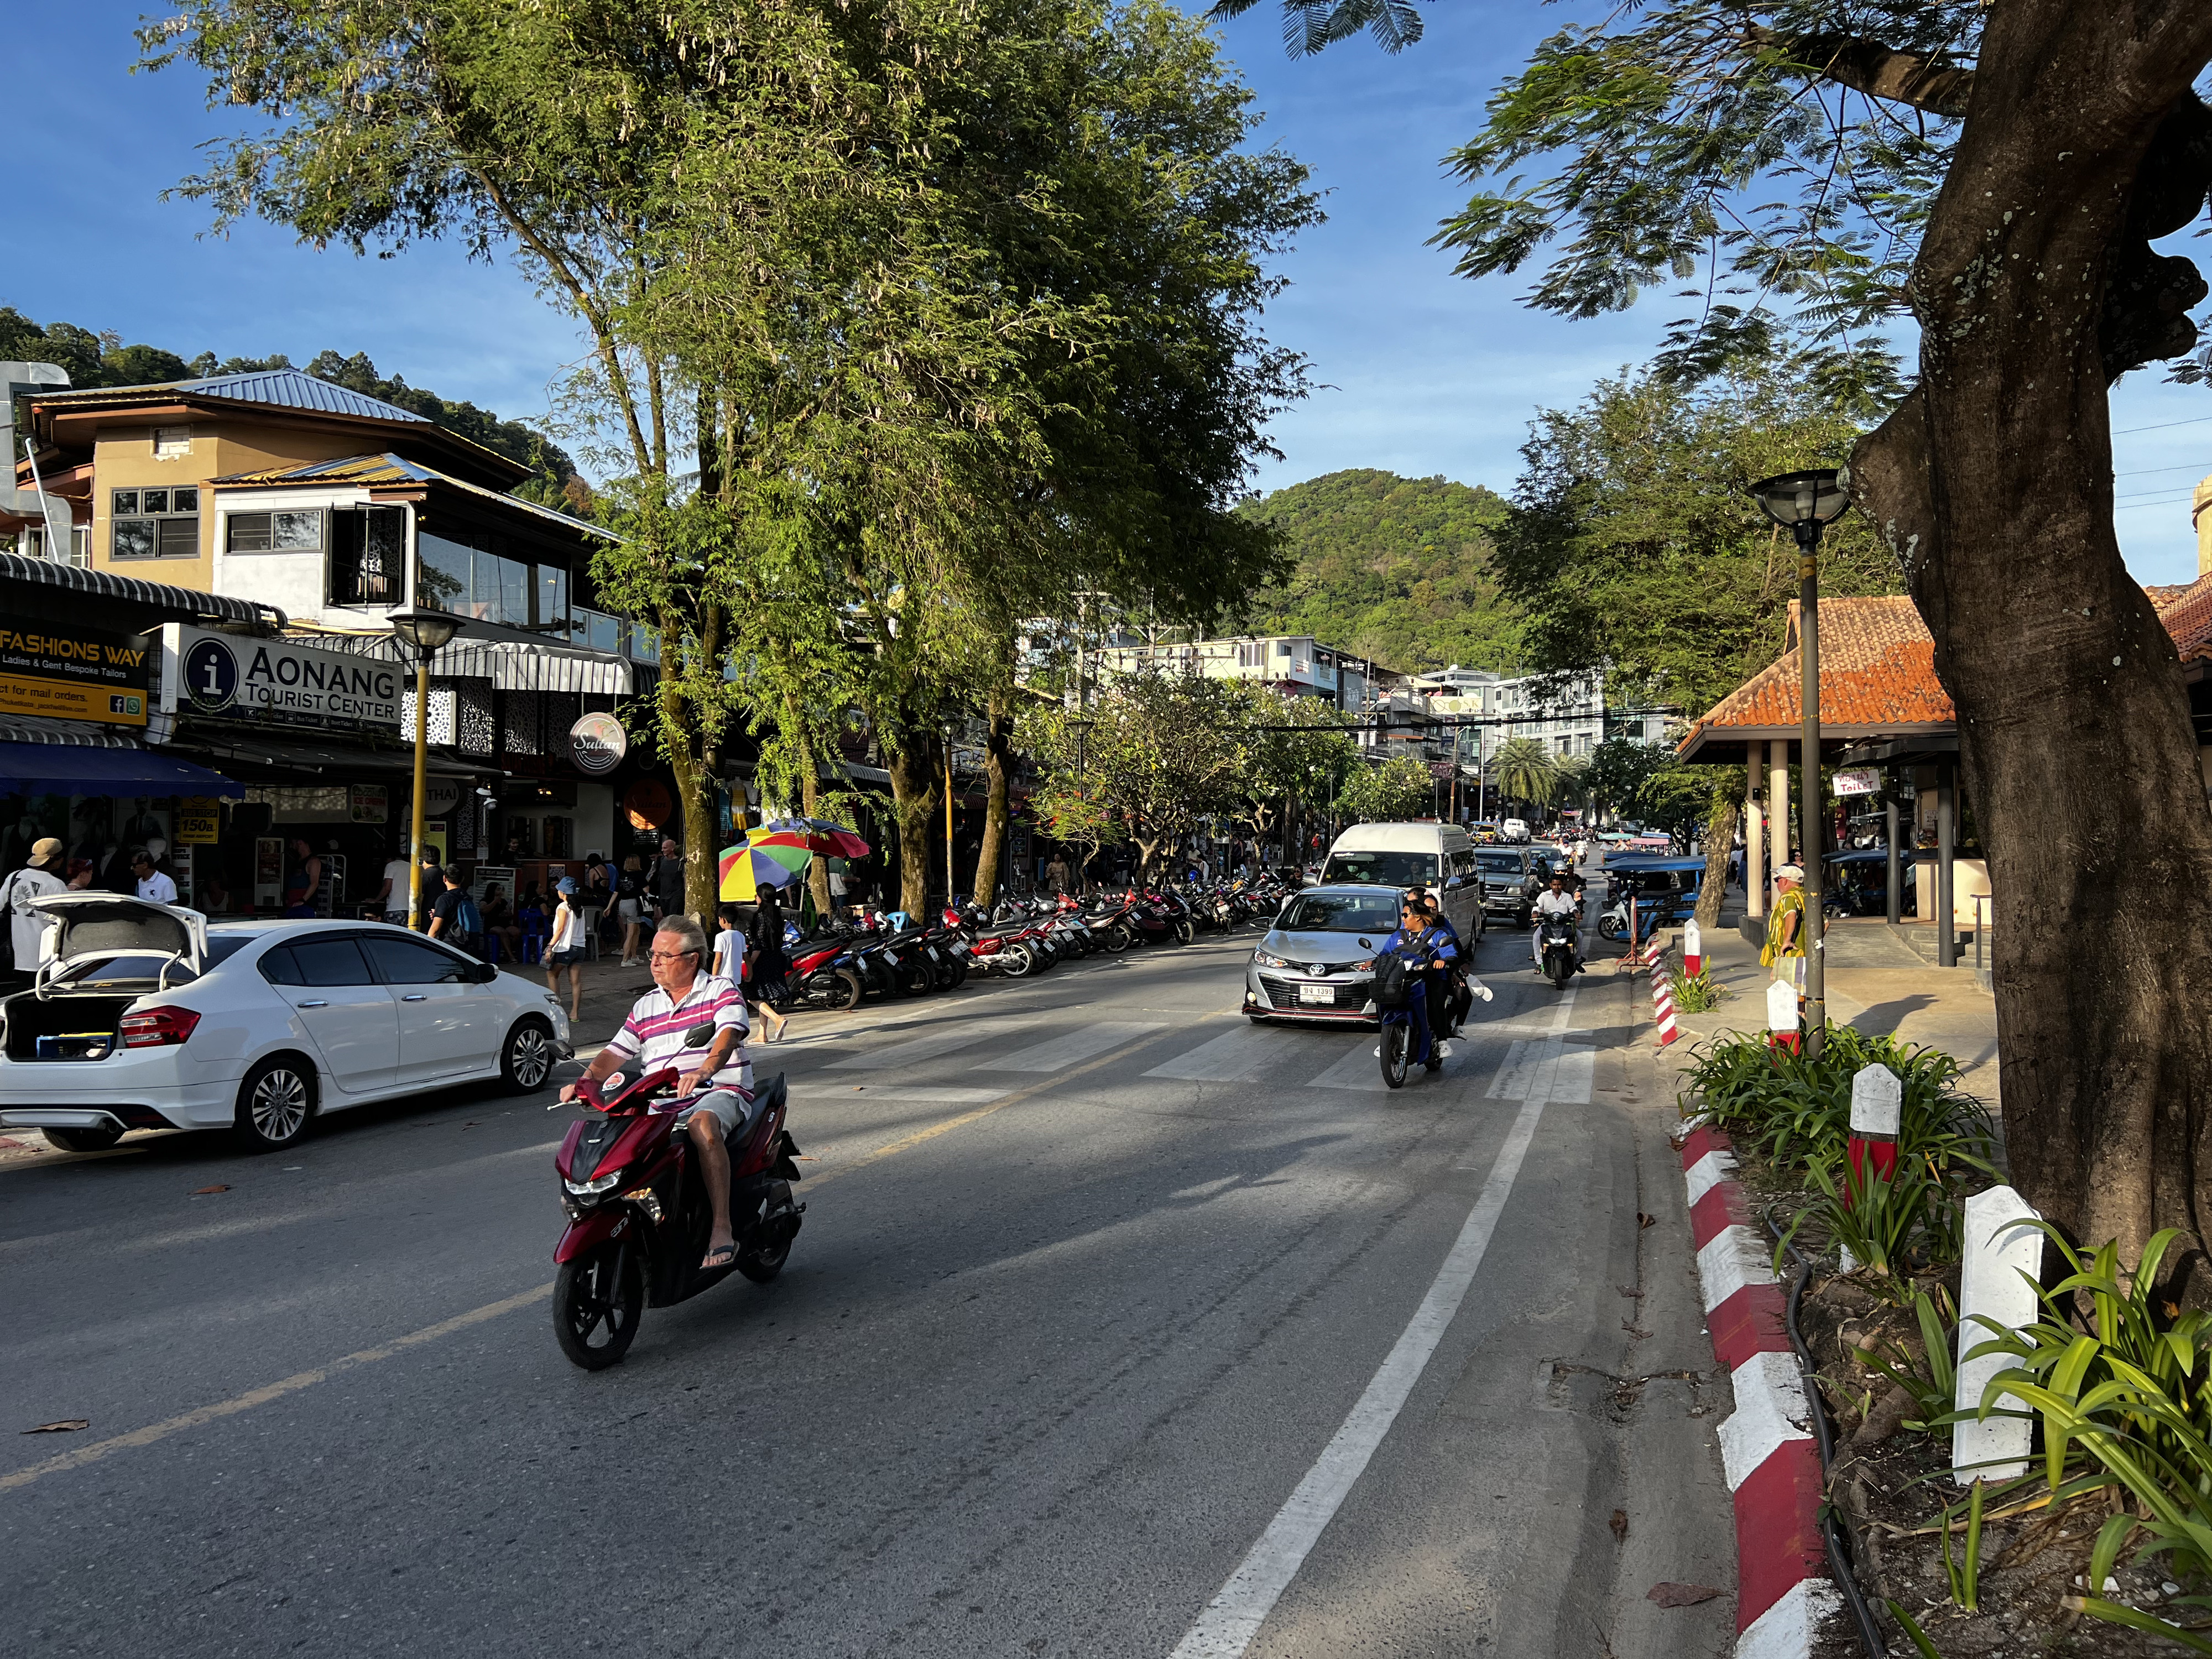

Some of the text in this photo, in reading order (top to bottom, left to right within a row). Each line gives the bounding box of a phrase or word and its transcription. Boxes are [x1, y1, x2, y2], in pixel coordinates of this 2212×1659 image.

[0, 630, 145, 667] FASHIONS WAY
[2, 654, 126, 678] Ladies & Gent Bespoke Tailors
[246, 646, 394, 700] AONANG
[12, 685, 27, 695] for
[30, 688, 50, 698] mail
[55, 691, 87, 702] orders.
[245, 682, 394, 719] TOURIST CENTER
[573, 732, 620, 750] Sultan
[627, 795, 666, 809] Sultan
